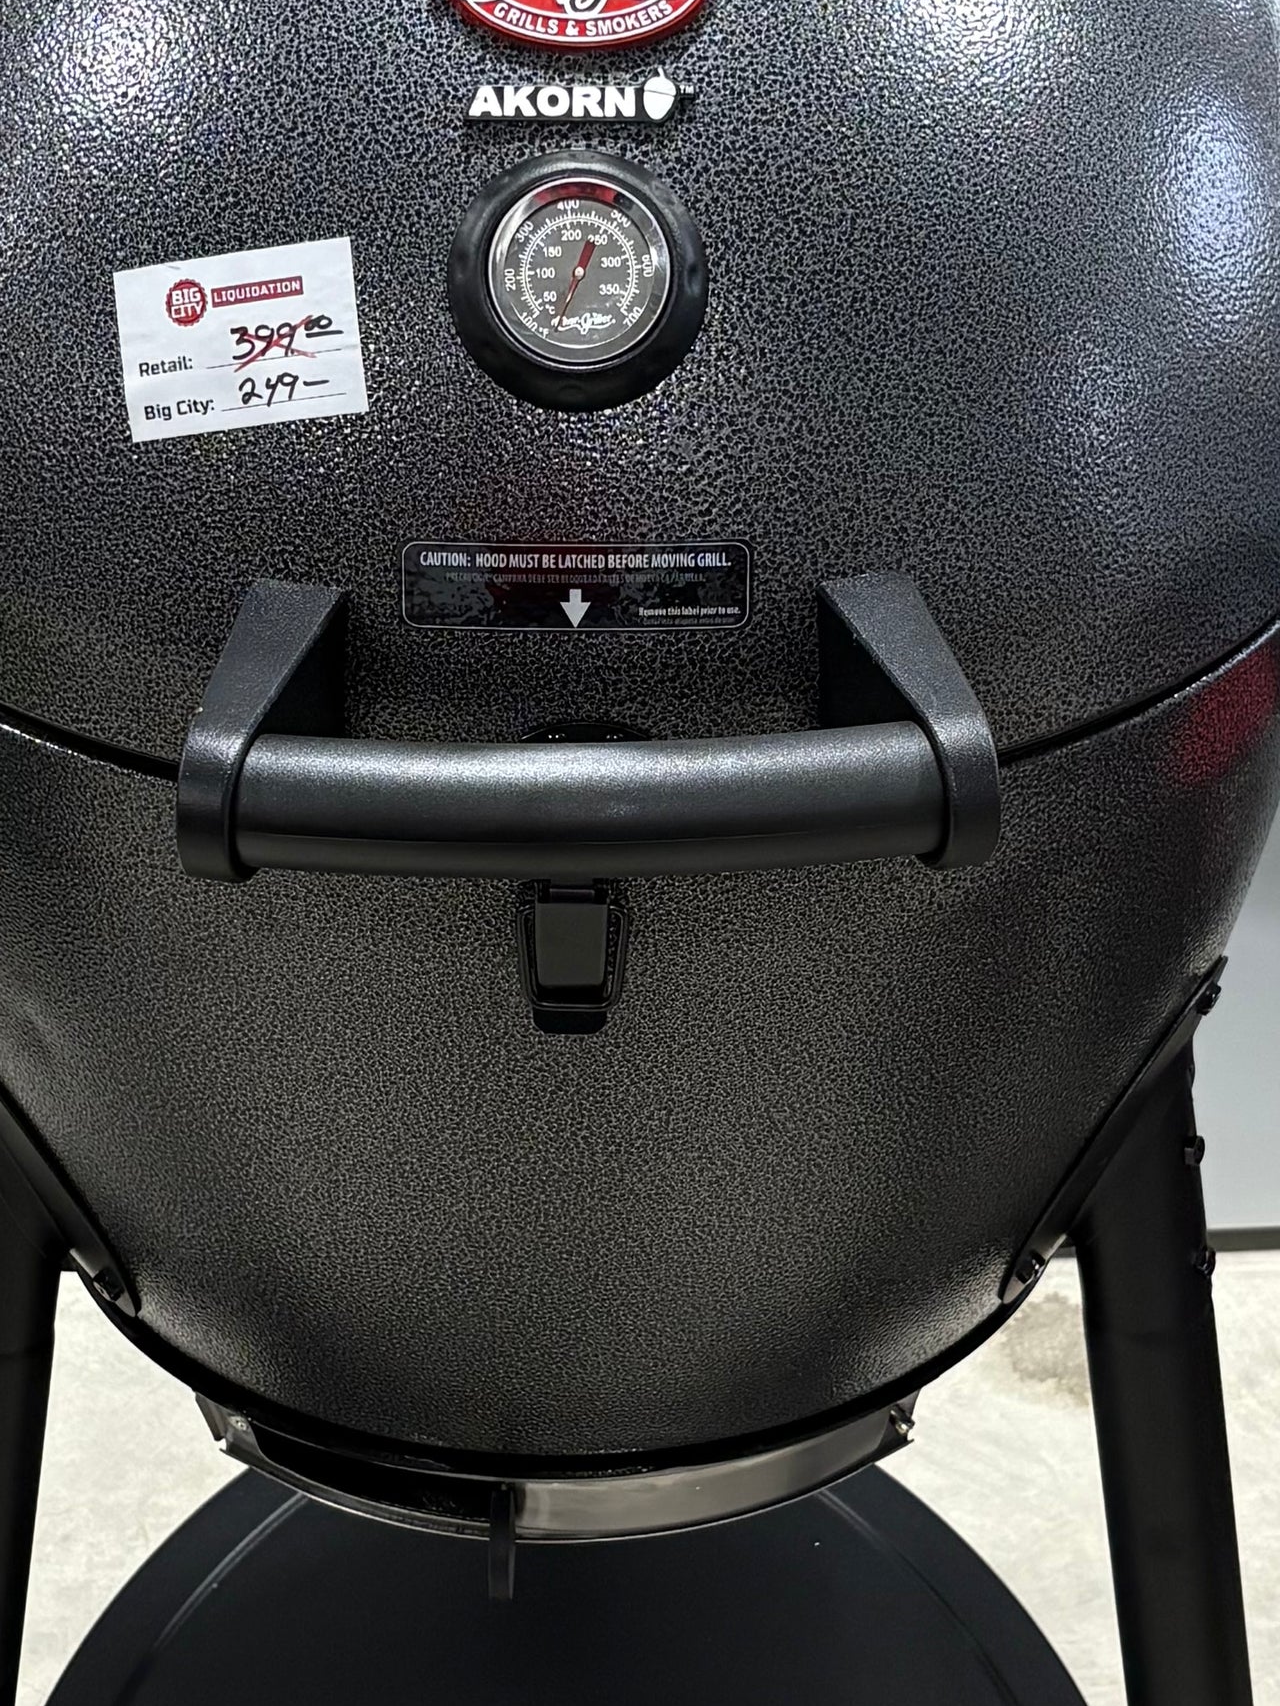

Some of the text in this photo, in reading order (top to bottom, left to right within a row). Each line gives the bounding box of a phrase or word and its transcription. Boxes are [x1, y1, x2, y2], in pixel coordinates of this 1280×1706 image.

[493, 1, 674, 37] GRILLS & SMOKERS
[468, 85, 637, 118] AKORN
[557, 199, 580, 210] 400
[514, 221, 534, 243] 300
[560, 229, 582, 241] 200
[543, 246, 562, 258] 150
[600, 257, 621, 268] 300
[504, 268, 517, 292] 200
[535, 267, 556, 279] 100
[171, 287, 202, 304] BIG
[213, 278, 302, 304] LIQUIDATION
[543, 291, 557, 302] 50
[598, 284, 620, 296] 350
[170, 301, 204, 319] CITY
[622, 306, 643, 328] 700
[138, 356, 194, 377] Retail:
[144, 404, 173, 421] Big
[176, 399, 216, 417] City:
[420, 551, 732, 569] CAUTION: HOOD MUST BE LATCHED BEFORE MOVING GRILL.
[718, 607, 726, 615] to
